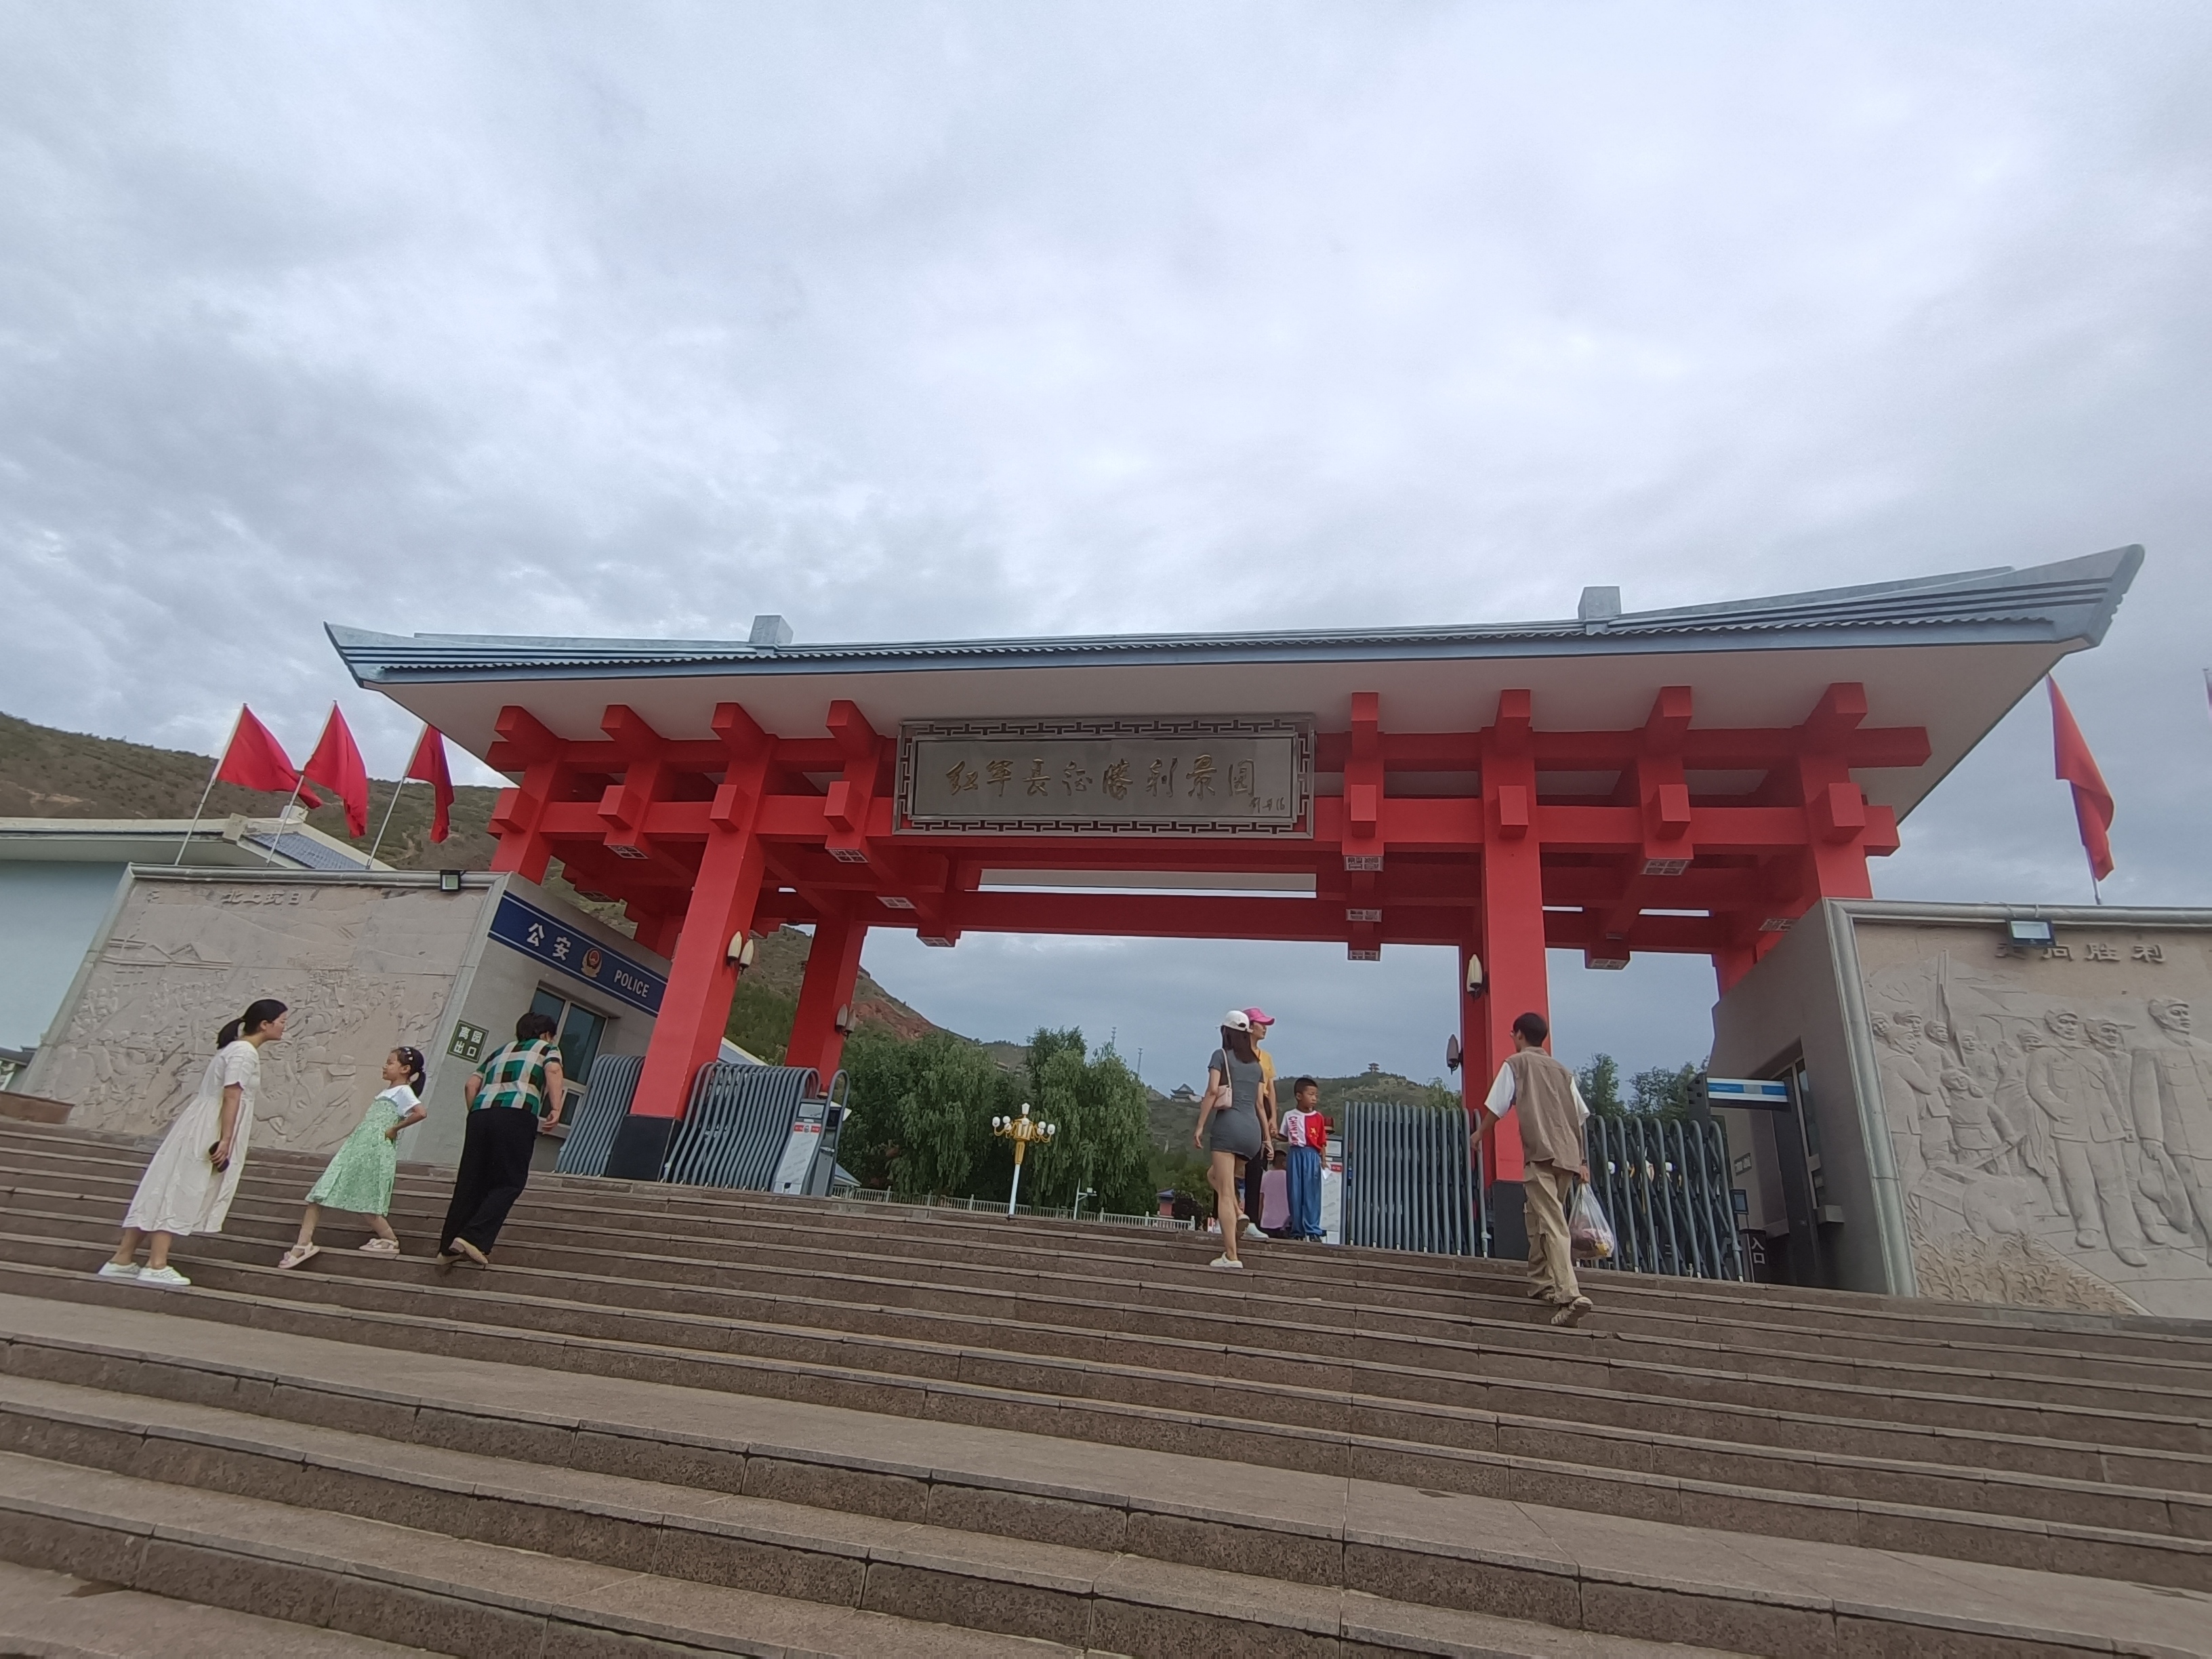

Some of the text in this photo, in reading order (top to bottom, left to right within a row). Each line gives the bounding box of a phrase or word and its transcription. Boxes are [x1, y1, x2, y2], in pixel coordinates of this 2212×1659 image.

[221, 889, 301, 905] 北上抗日
[527, 923, 650, 998] 公安 POLICE
[1751, 1237, 1765, 1265] 入口
